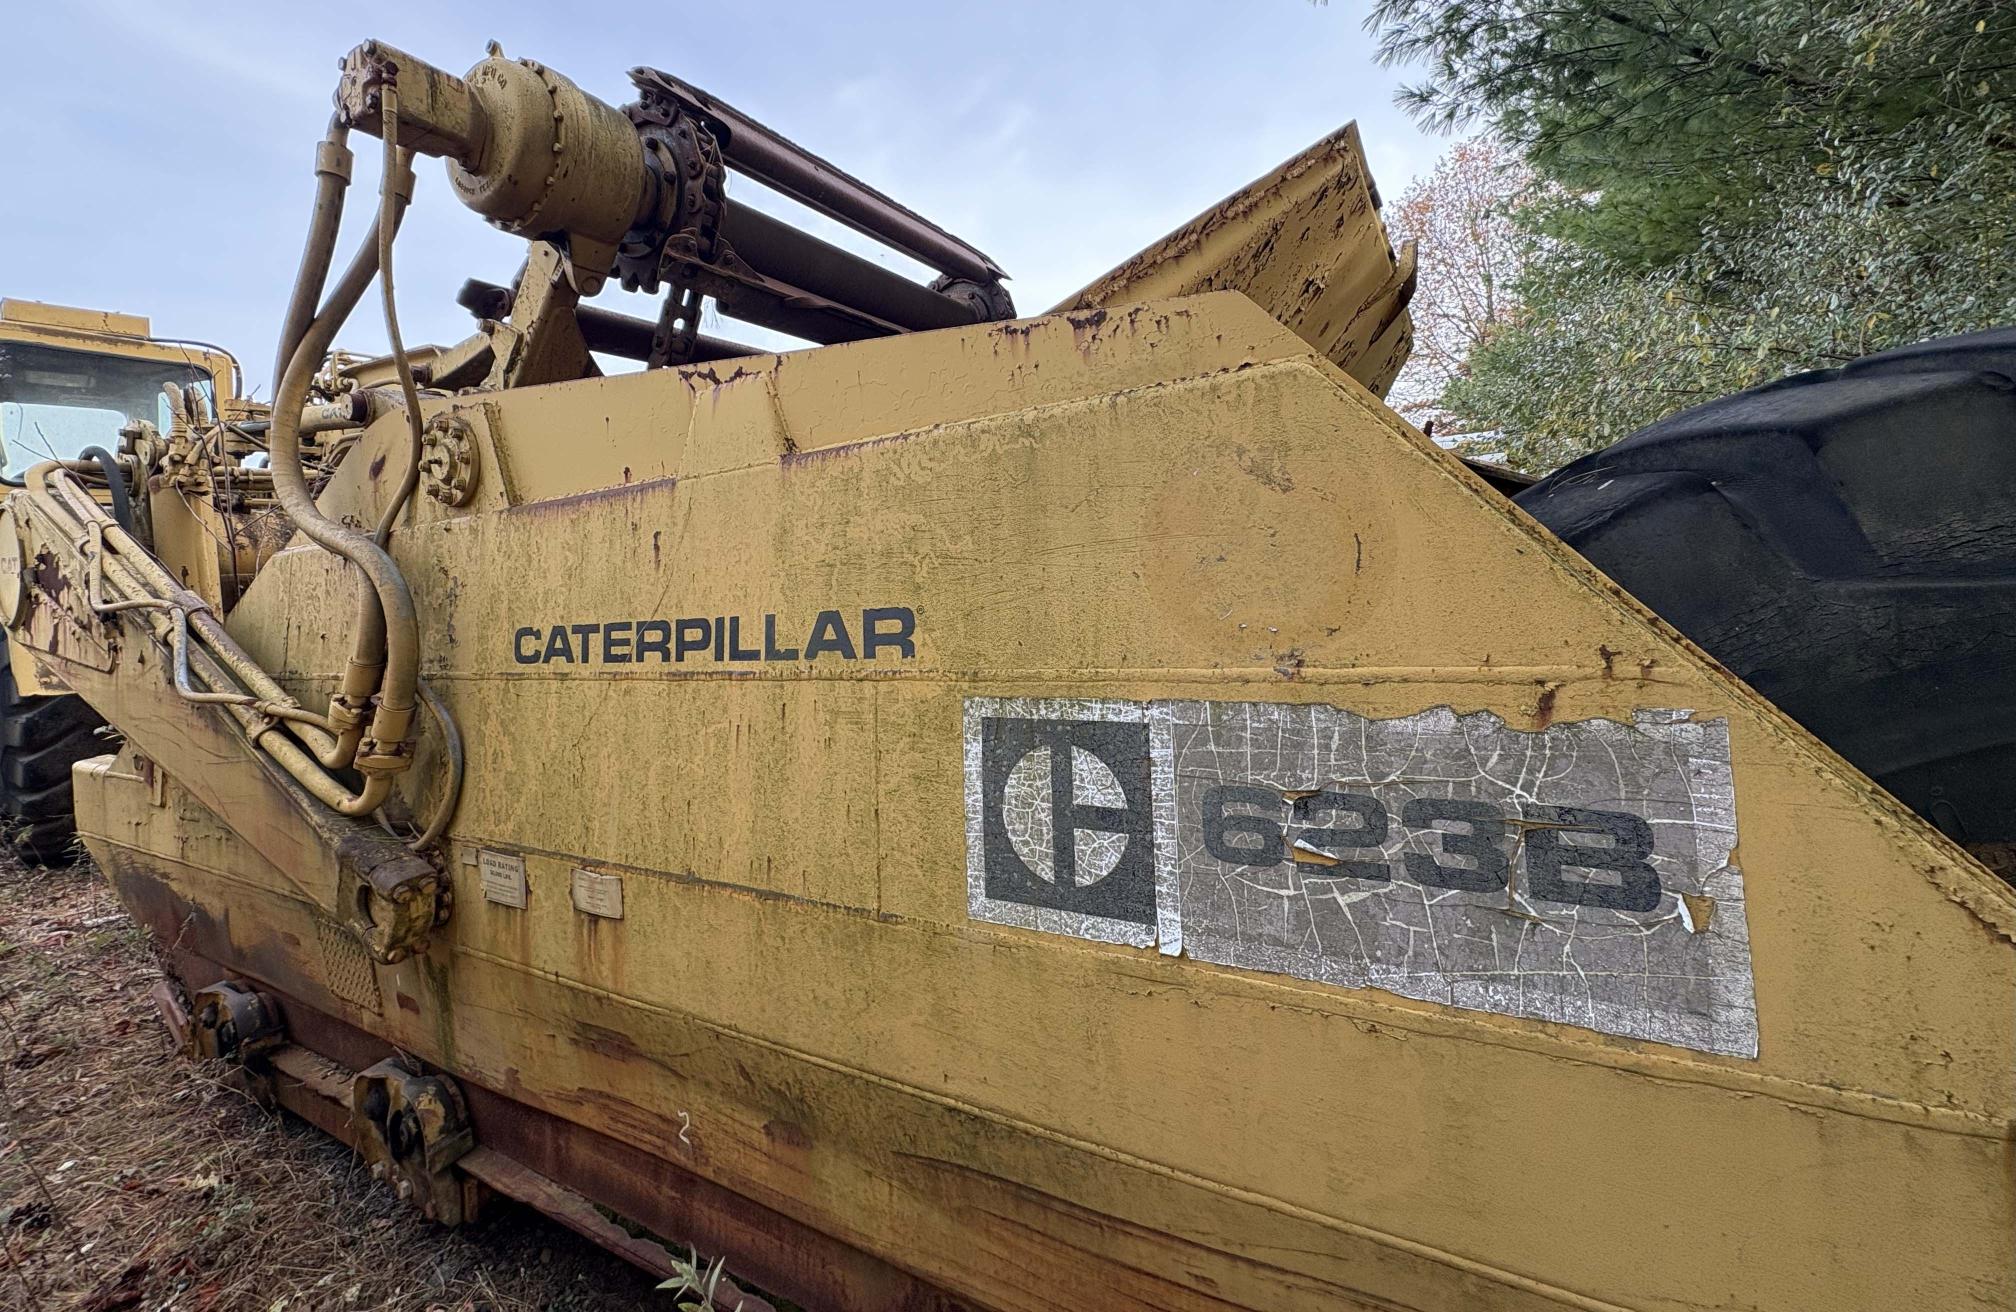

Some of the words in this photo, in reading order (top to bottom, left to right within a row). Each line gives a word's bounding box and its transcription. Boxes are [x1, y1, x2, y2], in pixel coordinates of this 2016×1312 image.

[513, 606, 917, 664] CATERPILLAR
[498, 861, 520, 873] RATING
[1202, 784, 1662, 913] 623B
